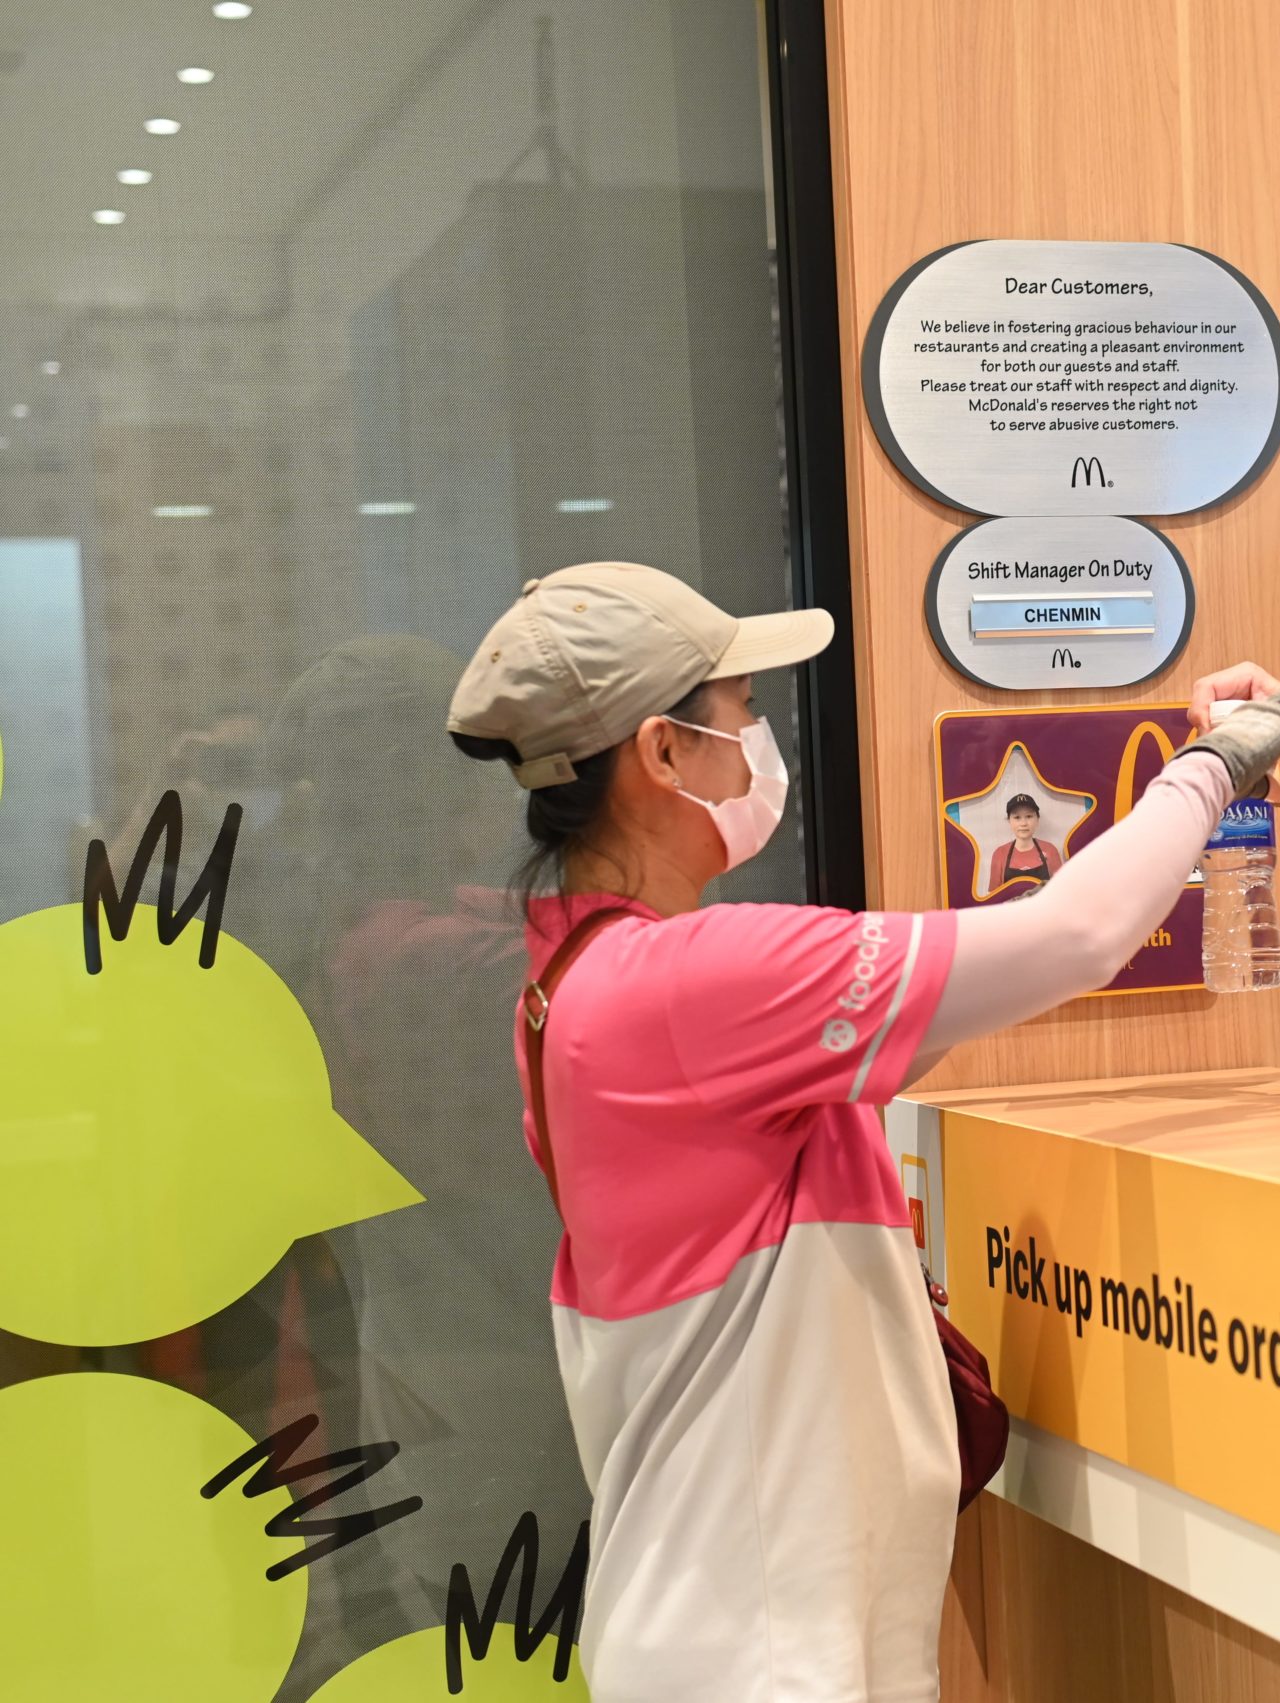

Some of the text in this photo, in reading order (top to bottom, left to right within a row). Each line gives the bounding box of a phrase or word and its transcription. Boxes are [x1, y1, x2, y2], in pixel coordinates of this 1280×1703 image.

[1005, 277, 1153, 297] Dear Customers,
[920, 320, 1237, 337] We believe in fostering gracious behaviour in our
[914, 340, 1245, 357] restaurants and creating a pleasant environment
[980, 359, 1180, 376] for both our guests and staff.
[920, 378, 1238, 396] Please treat our staff with respect and dignity.
[968, 397, 1198, 414] McDonald's reserves the right not
[989, 417, 1179, 431] to serve abusive customers.
[968, 559, 1153, 583] Shift Manager On Duty
[1024, 607, 1101, 623] CHENMIN
[986, 1225, 1049, 1308] Pick
[1053, 1261, 1093, 1339] up
[1100, 1273, 1219, 1365] mobile
